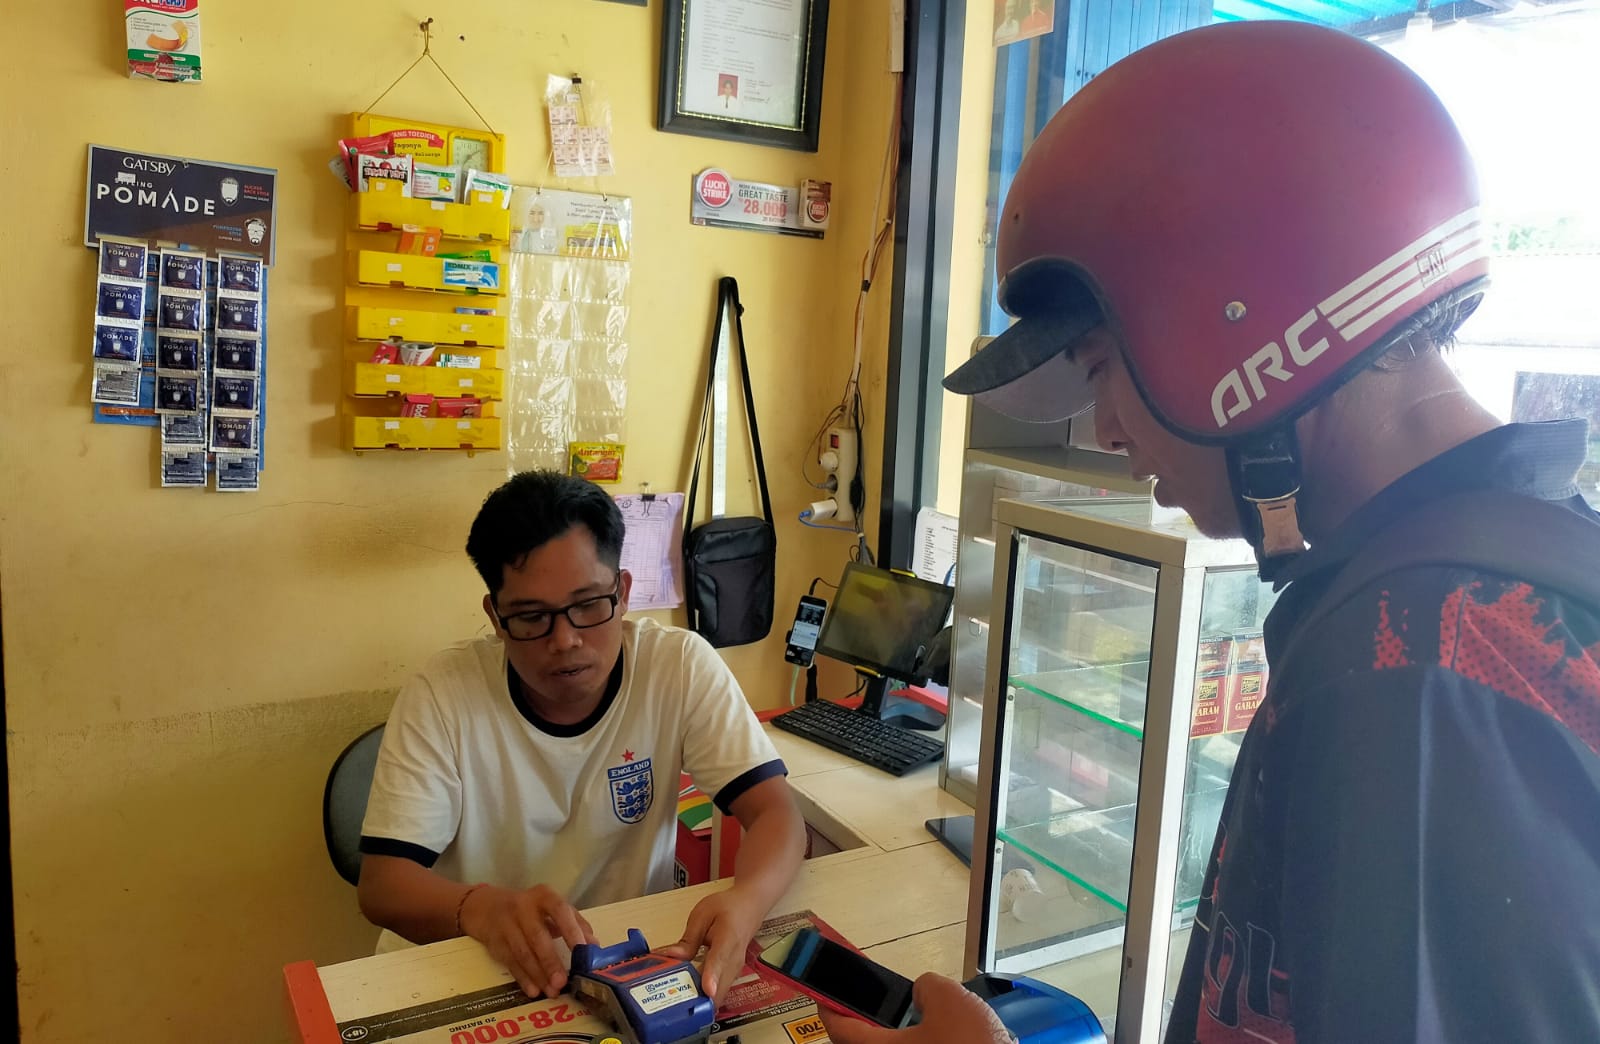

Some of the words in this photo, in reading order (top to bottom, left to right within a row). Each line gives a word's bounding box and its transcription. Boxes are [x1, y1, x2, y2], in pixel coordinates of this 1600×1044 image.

[122, 156, 176, 176] GATSBY
[705, 179, 727, 190] LUCKY
[96, 183, 216, 216] POMADE
[703, 189, 727, 200] STRIKE
[738, 189, 762, 199] GREAT
[764, 192, 789, 202] TASTE
[743, 199, 788, 217] 28.000
[1211, 308, 1330, 428] ARC
[1195, 706, 1220, 717] ARAM
[611, 761, 650, 777] ENGLAND
[677, 983, 692, 992] VISA
[449, 1020, 483, 1033] BATANG
[450, 1004, 575, 1044] 28.000
[795, 1020, 826, 1036] .700
